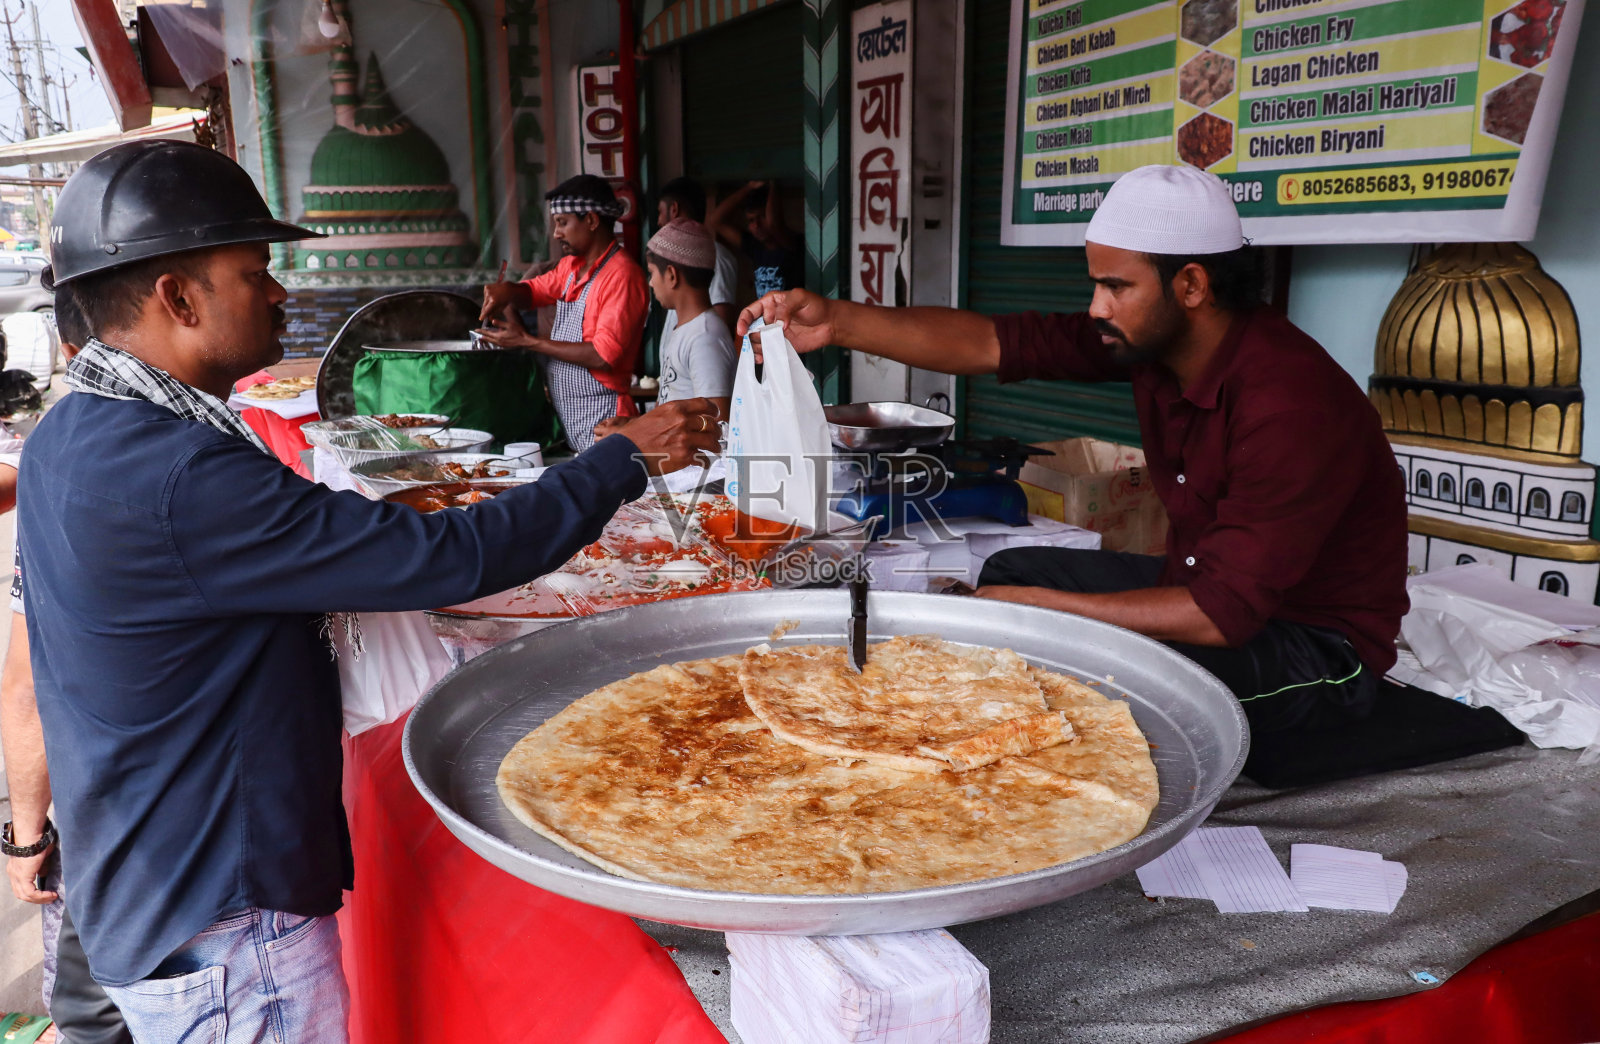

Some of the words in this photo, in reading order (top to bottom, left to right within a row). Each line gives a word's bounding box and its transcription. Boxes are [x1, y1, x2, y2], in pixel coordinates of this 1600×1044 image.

[1037, 14, 1064, 36] Kulcha
[1066, 6, 1082, 27] Roti
[1254, 24, 1321, 53] Chicken
[1326, 16, 1355, 41] Fry
[857, 16, 907, 63] হোটেল
[1037, 43, 1068, 65] Chicken
[1070, 36, 1087, 57] Boti
[1089, 27, 1116, 50] Kabab
[1037, 72, 1068, 94] Chicken
[1070, 66, 1091, 87] Kofta
[1251, 63, 1301, 88] Lagan
[1306, 51, 1380, 80] Chicken
[1036, 100, 1068, 122] Chicken
[1070, 92, 1101, 117] Afghani
[1103, 90, 1121, 109] Kali
[1123, 84, 1151, 106] Mirch
[1250, 98, 1317, 124] Chicken
[1322, 88, 1374, 116] Malai
[1379, 78, 1458, 112] Hariyali
[1036, 129, 1068, 150] Chicken
[1070, 125, 1093, 145] Malai
[1249, 133, 1315, 158] Chicken
[1320, 125, 1385, 155] Biryani
[1035, 157, 1068, 178] Chicken
[1069, 155, 1099, 175] Masala
[1302, 173, 1416, 195] 8052685683,
[1422, 167, 1515, 190] 9198067
[1033, 192, 1077, 213] Marriage
